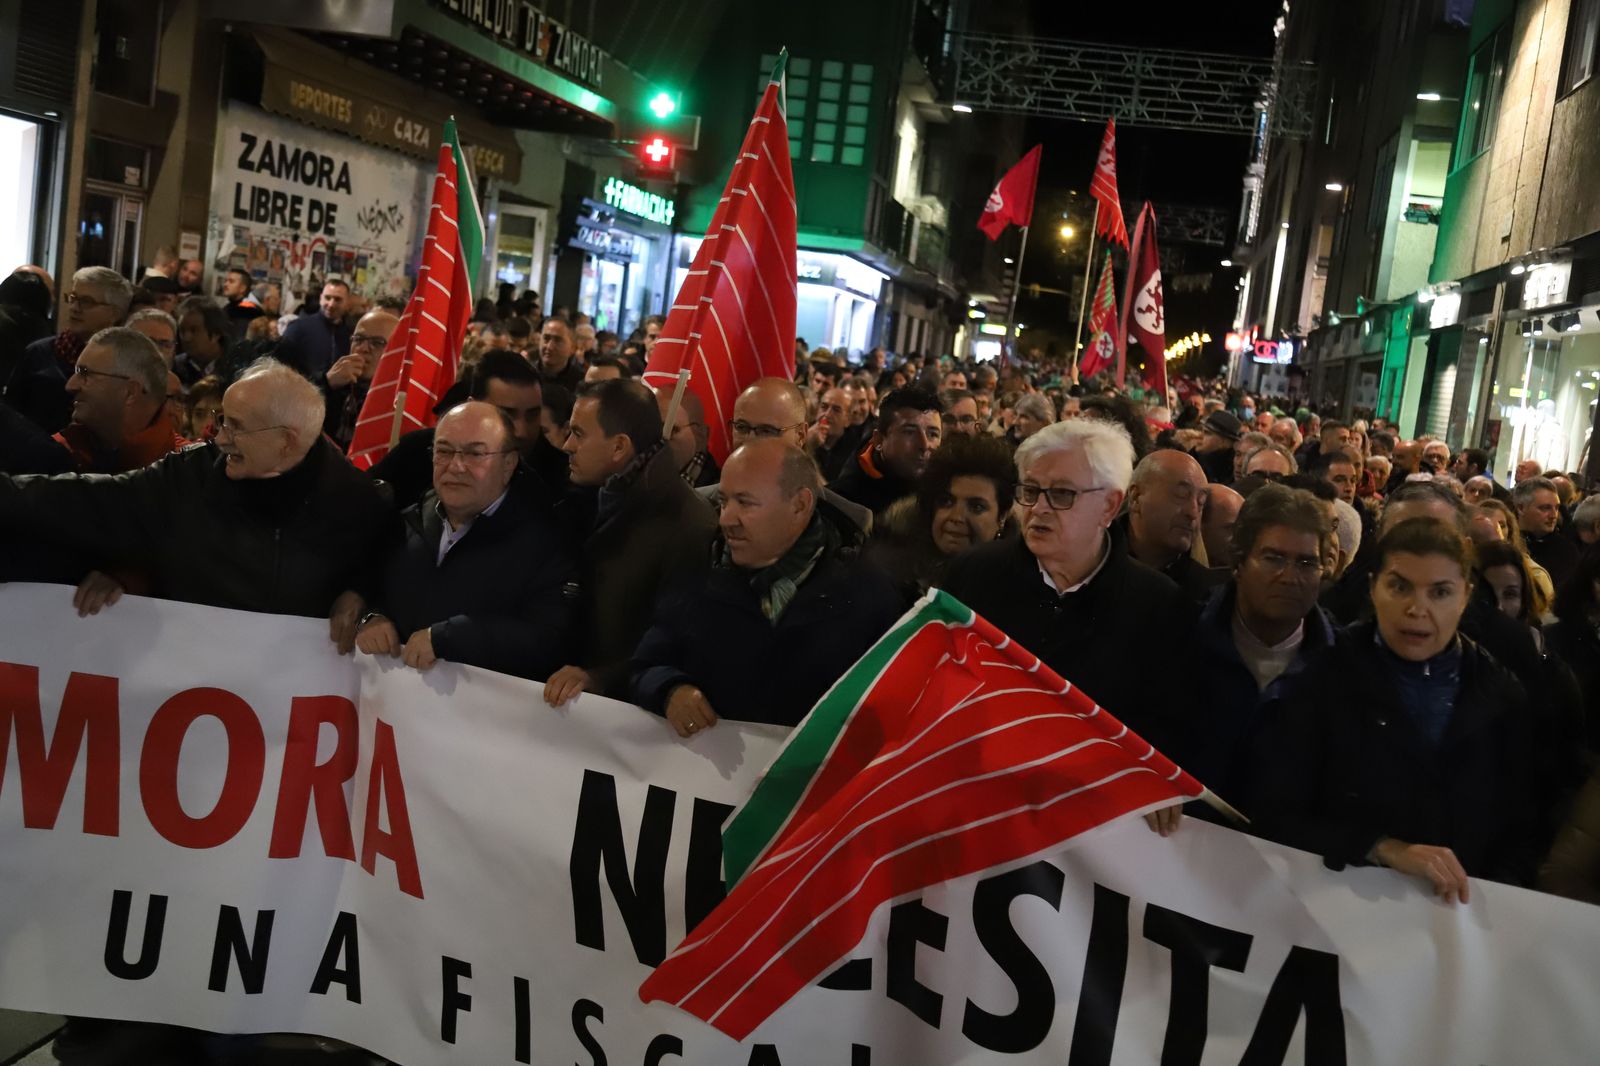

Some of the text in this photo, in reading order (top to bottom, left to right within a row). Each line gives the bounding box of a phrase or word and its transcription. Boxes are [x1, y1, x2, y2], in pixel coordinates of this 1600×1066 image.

[525, 8, 546, 56] DE
[291, 81, 505, 173] DEPORTES CAZA ESCA
[237, 132, 352, 195] ZAMORA
[233, 182, 338, 236] LIBRE DE
[104, 890, 361, 1005] UNA
